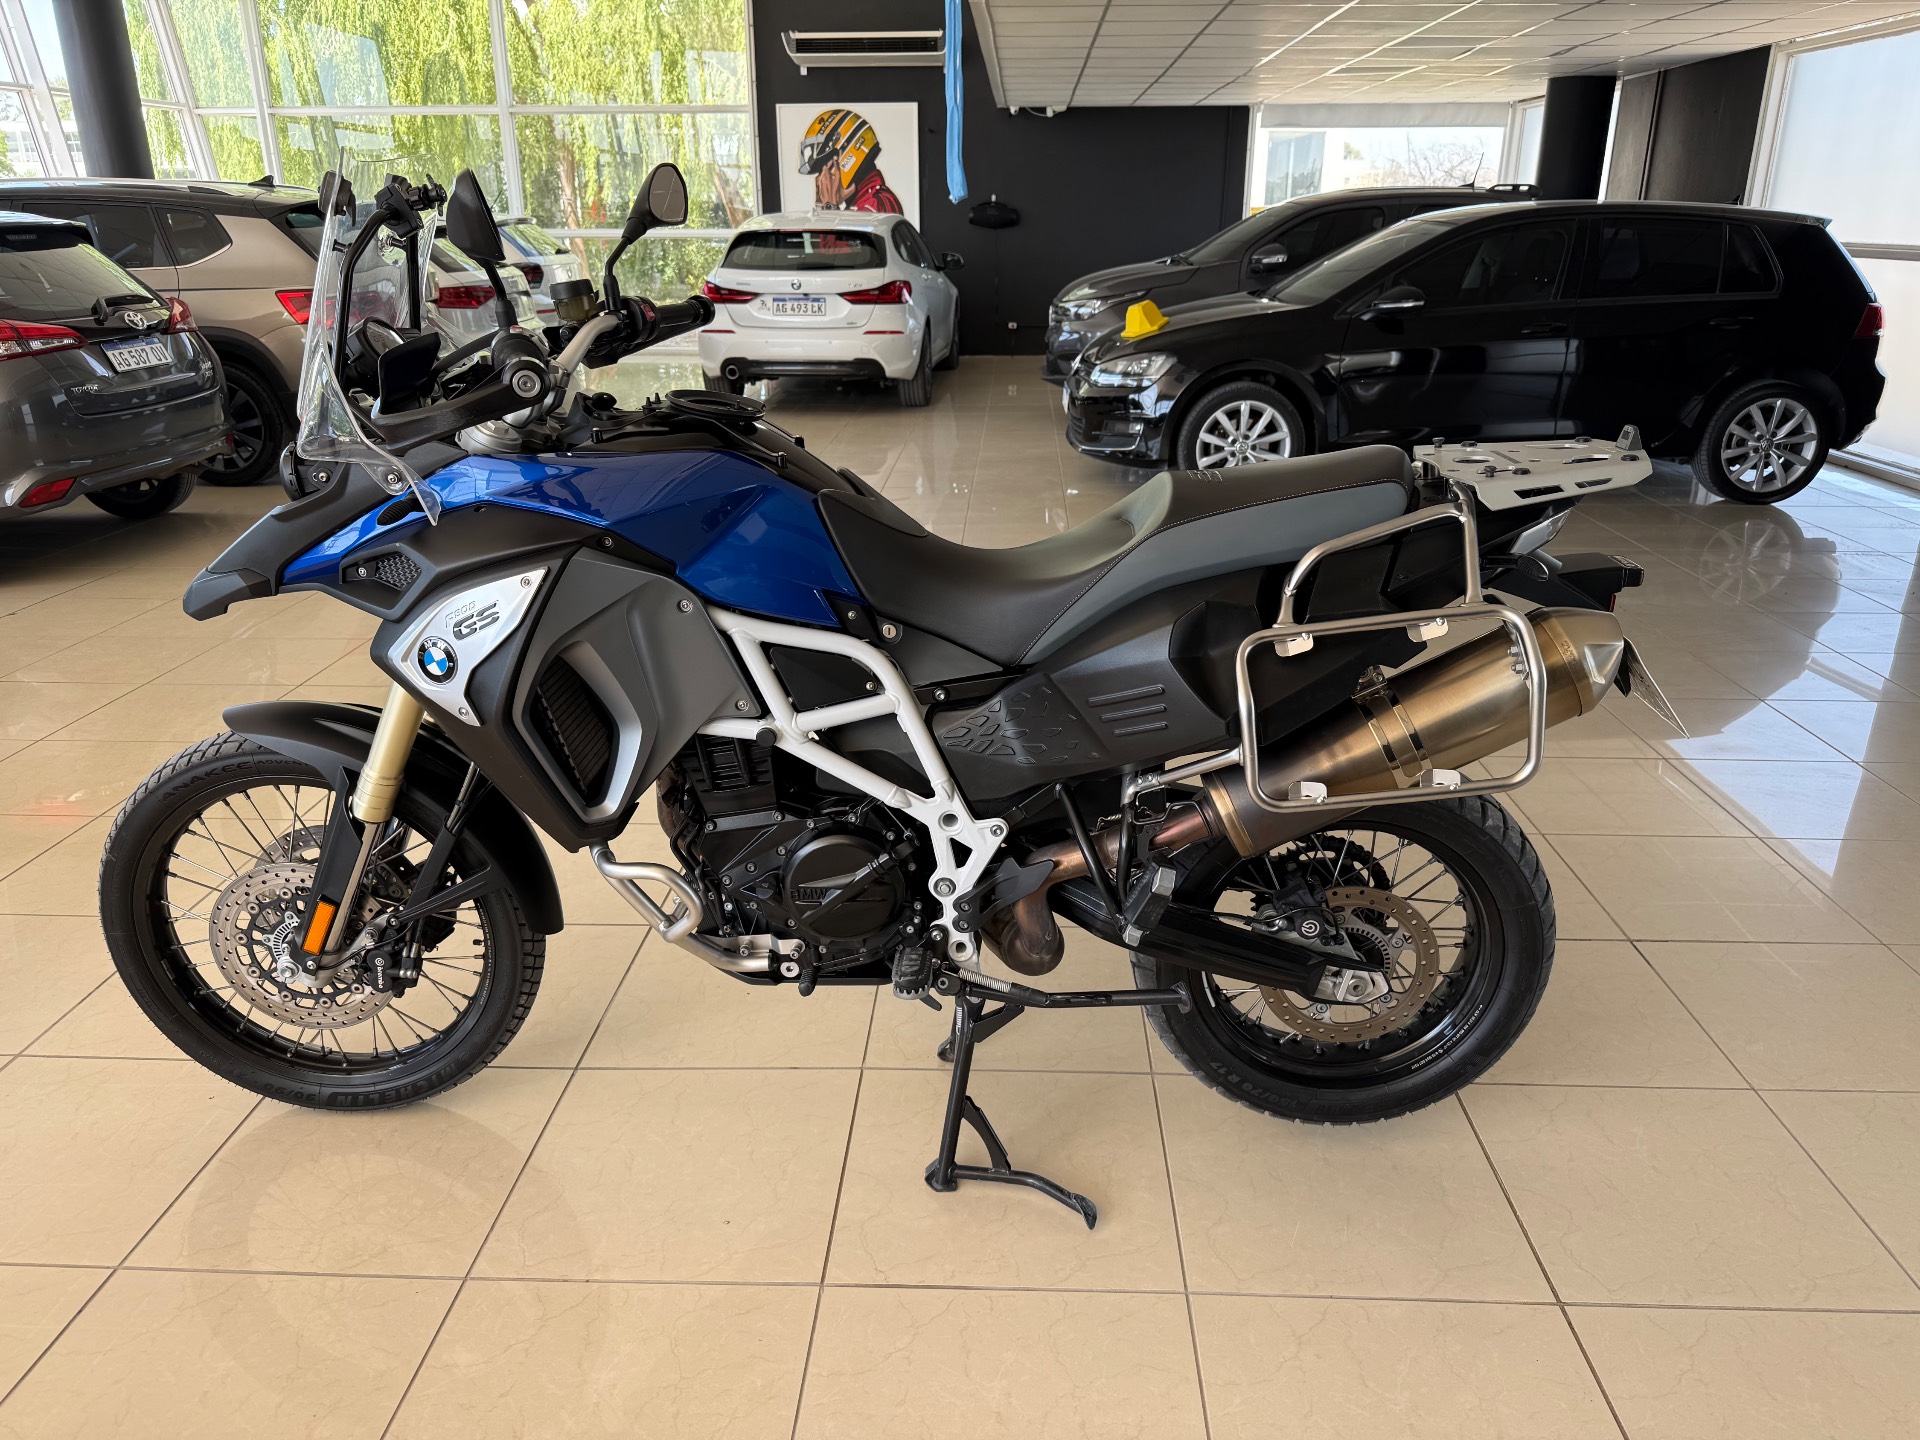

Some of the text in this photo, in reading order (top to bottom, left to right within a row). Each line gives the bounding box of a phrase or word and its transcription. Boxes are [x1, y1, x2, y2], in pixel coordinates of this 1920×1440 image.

[775, 303, 787, 314] AG
[790, 303, 808, 314] 493
[112, 352, 132, 369] AG
[128, 348, 152, 366] 587
[71, 384, 99, 394] TOYOTA
[453, 602, 500, 641] GS
[162, 760, 253, 800] ANAKEE
[790, 888, 827, 900] BMW
[377, 967, 385, 989] brembo
[335, 1060, 457, 1107] MICHELIN
